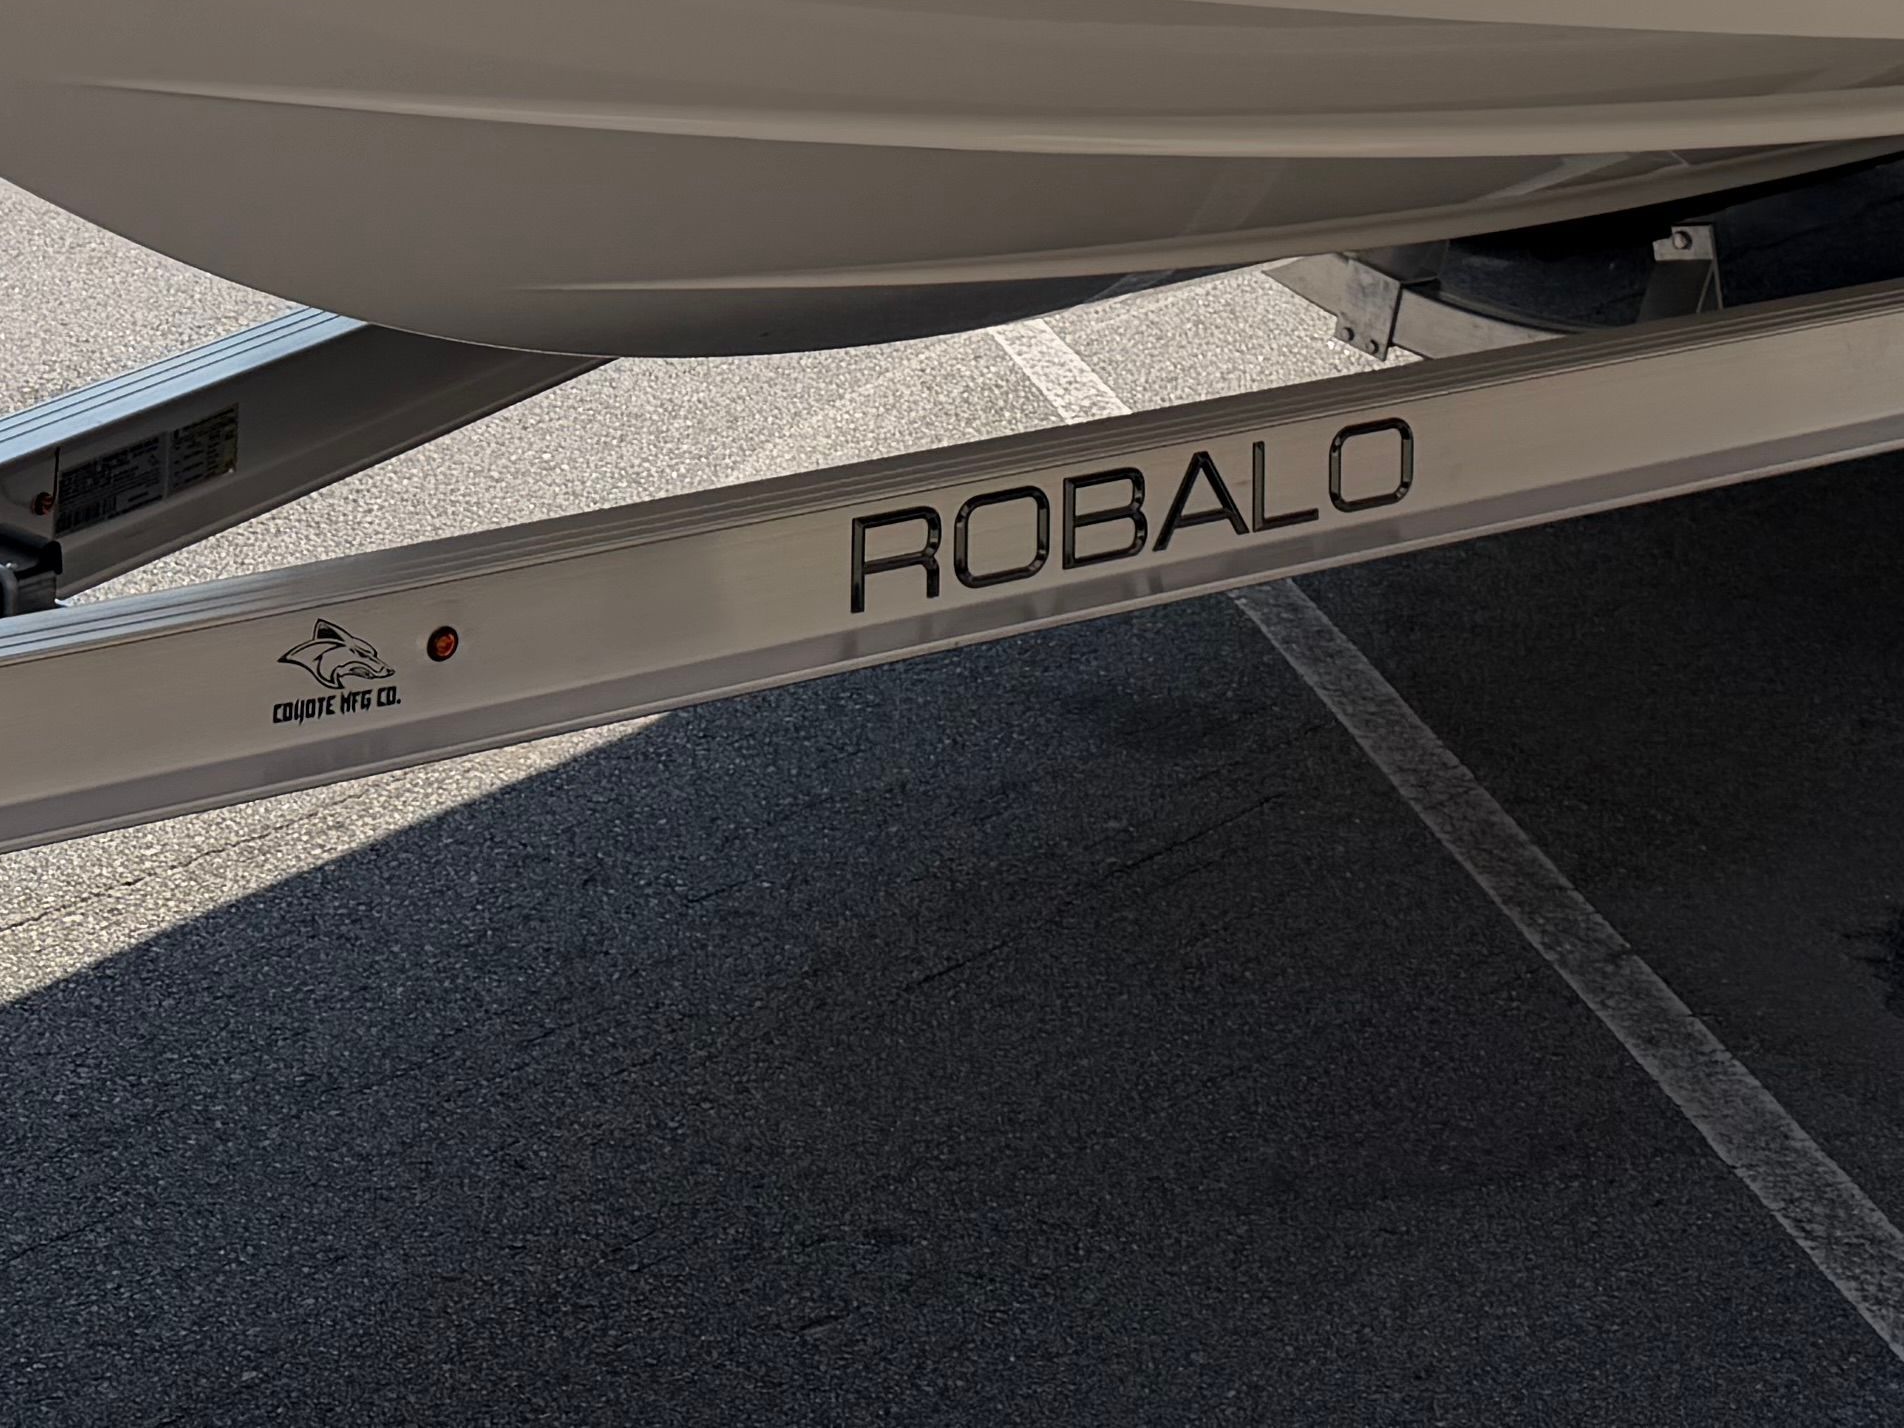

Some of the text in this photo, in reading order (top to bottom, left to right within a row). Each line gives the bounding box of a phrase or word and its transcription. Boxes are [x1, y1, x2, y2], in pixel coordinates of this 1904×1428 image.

[850, 417, 1414, 614] ROBALO
[273, 686, 402, 726] COYOTE MFG CO.
